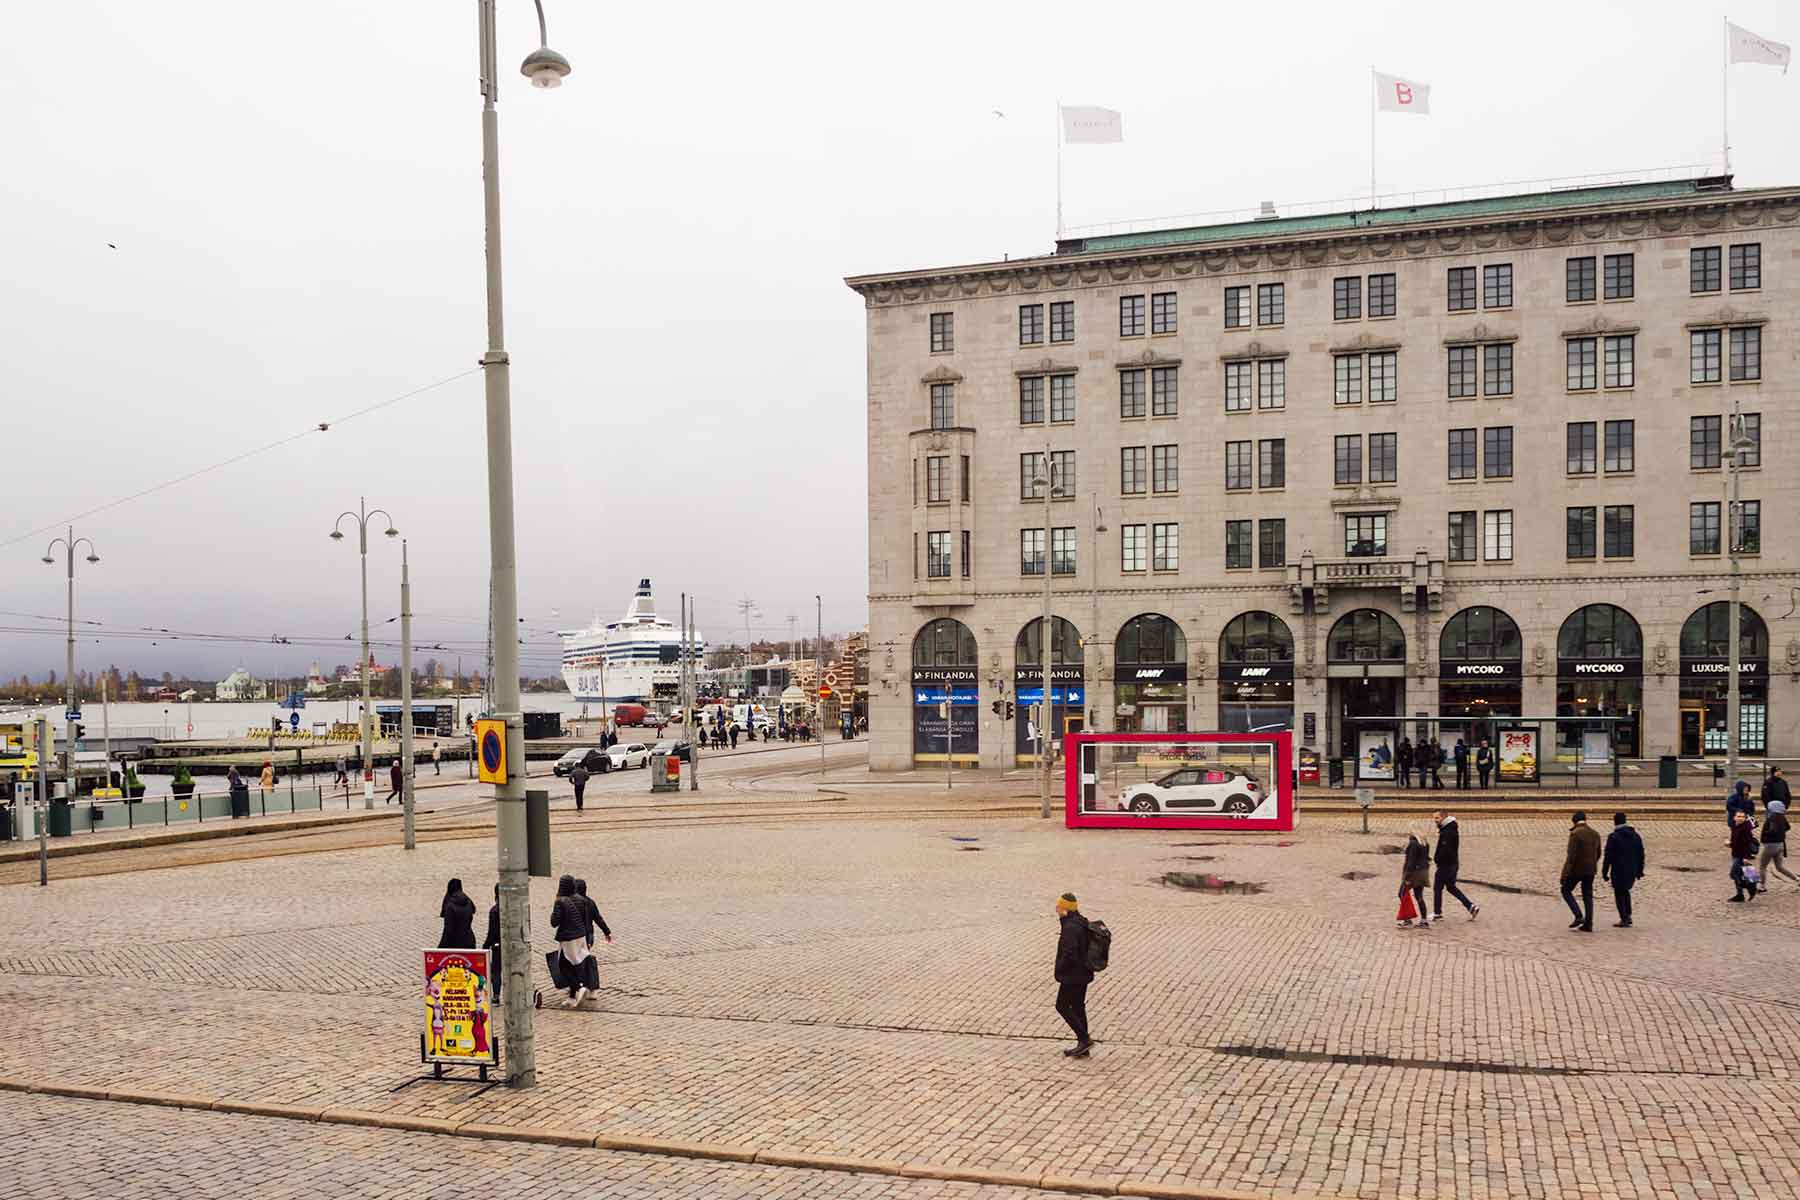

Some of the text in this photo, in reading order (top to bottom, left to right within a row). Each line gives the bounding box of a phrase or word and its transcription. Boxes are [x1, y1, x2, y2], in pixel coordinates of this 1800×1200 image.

[1396, 83, 1412, 104] B
[1241, 668, 1270, 676] LAMY
[1457, 666, 1504, 674] MYCOKO
[1576, 664, 1624, 673] MYCOKO
[924, 671, 975, 680] FINLANDIA
[1028, 671, 1080, 679] FINANDIA
[1136, 669, 1164, 678] LAMY
